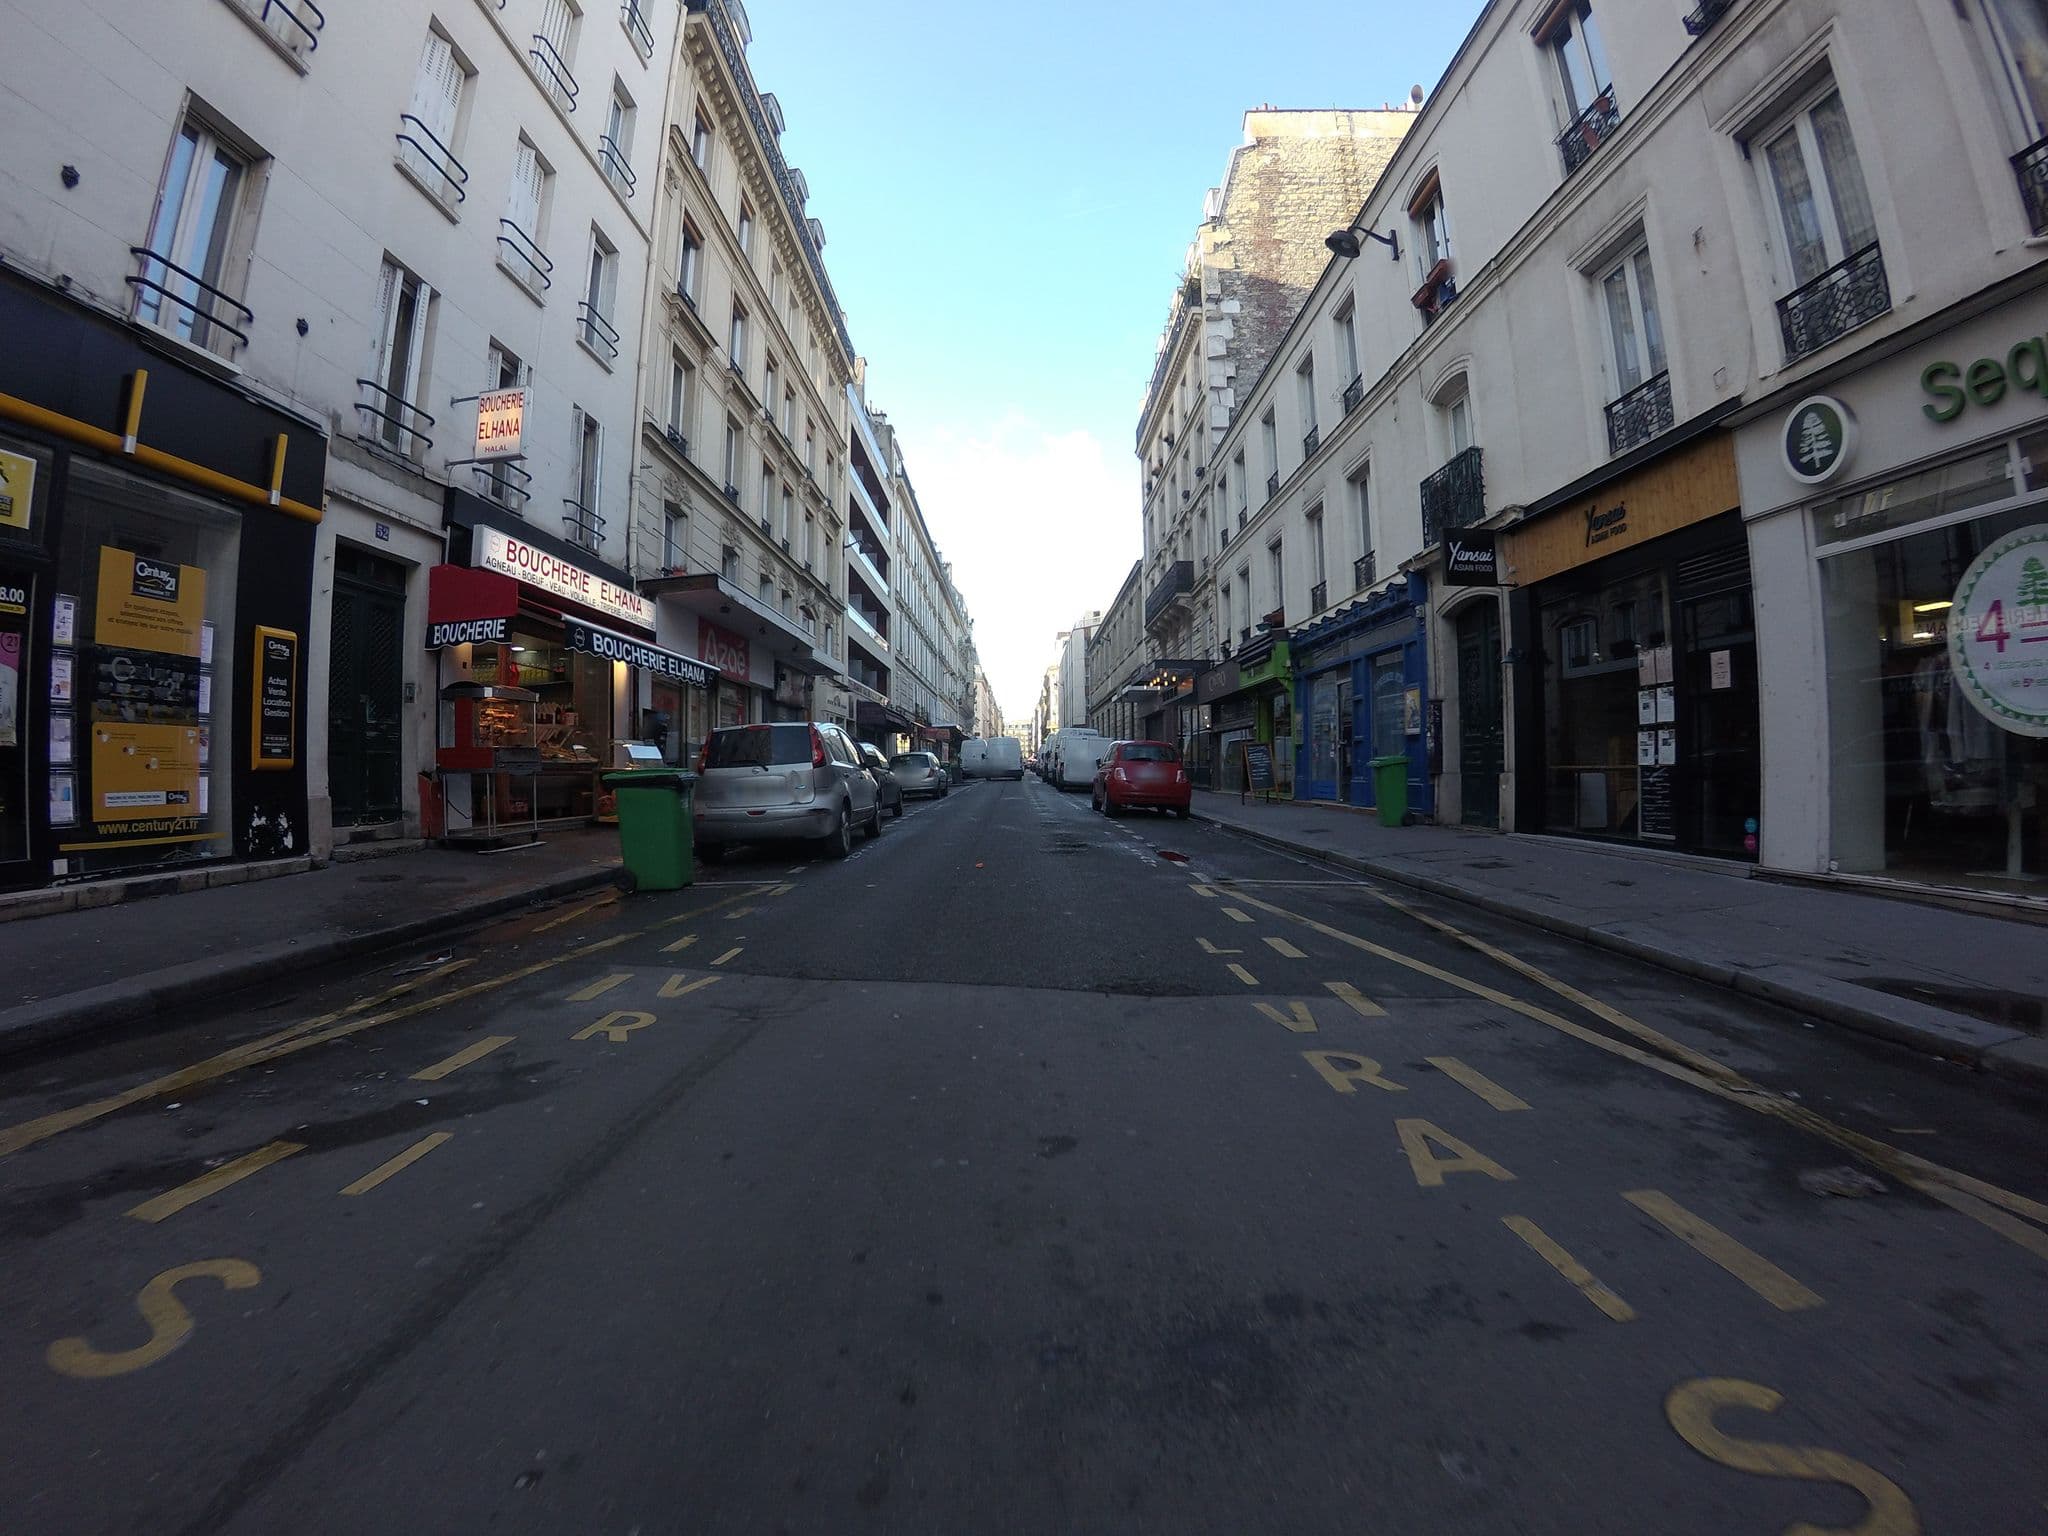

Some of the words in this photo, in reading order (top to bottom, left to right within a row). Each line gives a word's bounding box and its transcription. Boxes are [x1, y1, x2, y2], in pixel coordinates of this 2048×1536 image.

[480, 392, 524, 414] BOUCHERIE
[479, 418, 520, 439] ELHANA
[485, 444, 508, 453] HALAL
[1584, 500, 1627, 547] Yansai
[1449, 541, 1494, 570] Yansai
[136, 561, 171, 581] Century
[165, 577, 176, 592] 21
[486, 556, 517, 576] AGNEAU
[522, 570, 544, 585] BOEUF
[550, 581, 566, 595] VEAU
[506, 539, 590, 593] BOUCHERIE
[601, 582, 643, 616] ELHANA
[434, 619, 506, 645] BOUCHERIE
[1976, 600, 2010, 652] 4
[592, 633, 667, 672] BOUCHERIE
[668, 657, 706, 684] ELHANA
[268, 676, 288, 686] Achat
[268, 687, 287, 697] Vente
[263, 697, 291, 708] Location
[264, 708, 290, 718] Gestion
[97, 817, 199, 834] www.century21.fr
